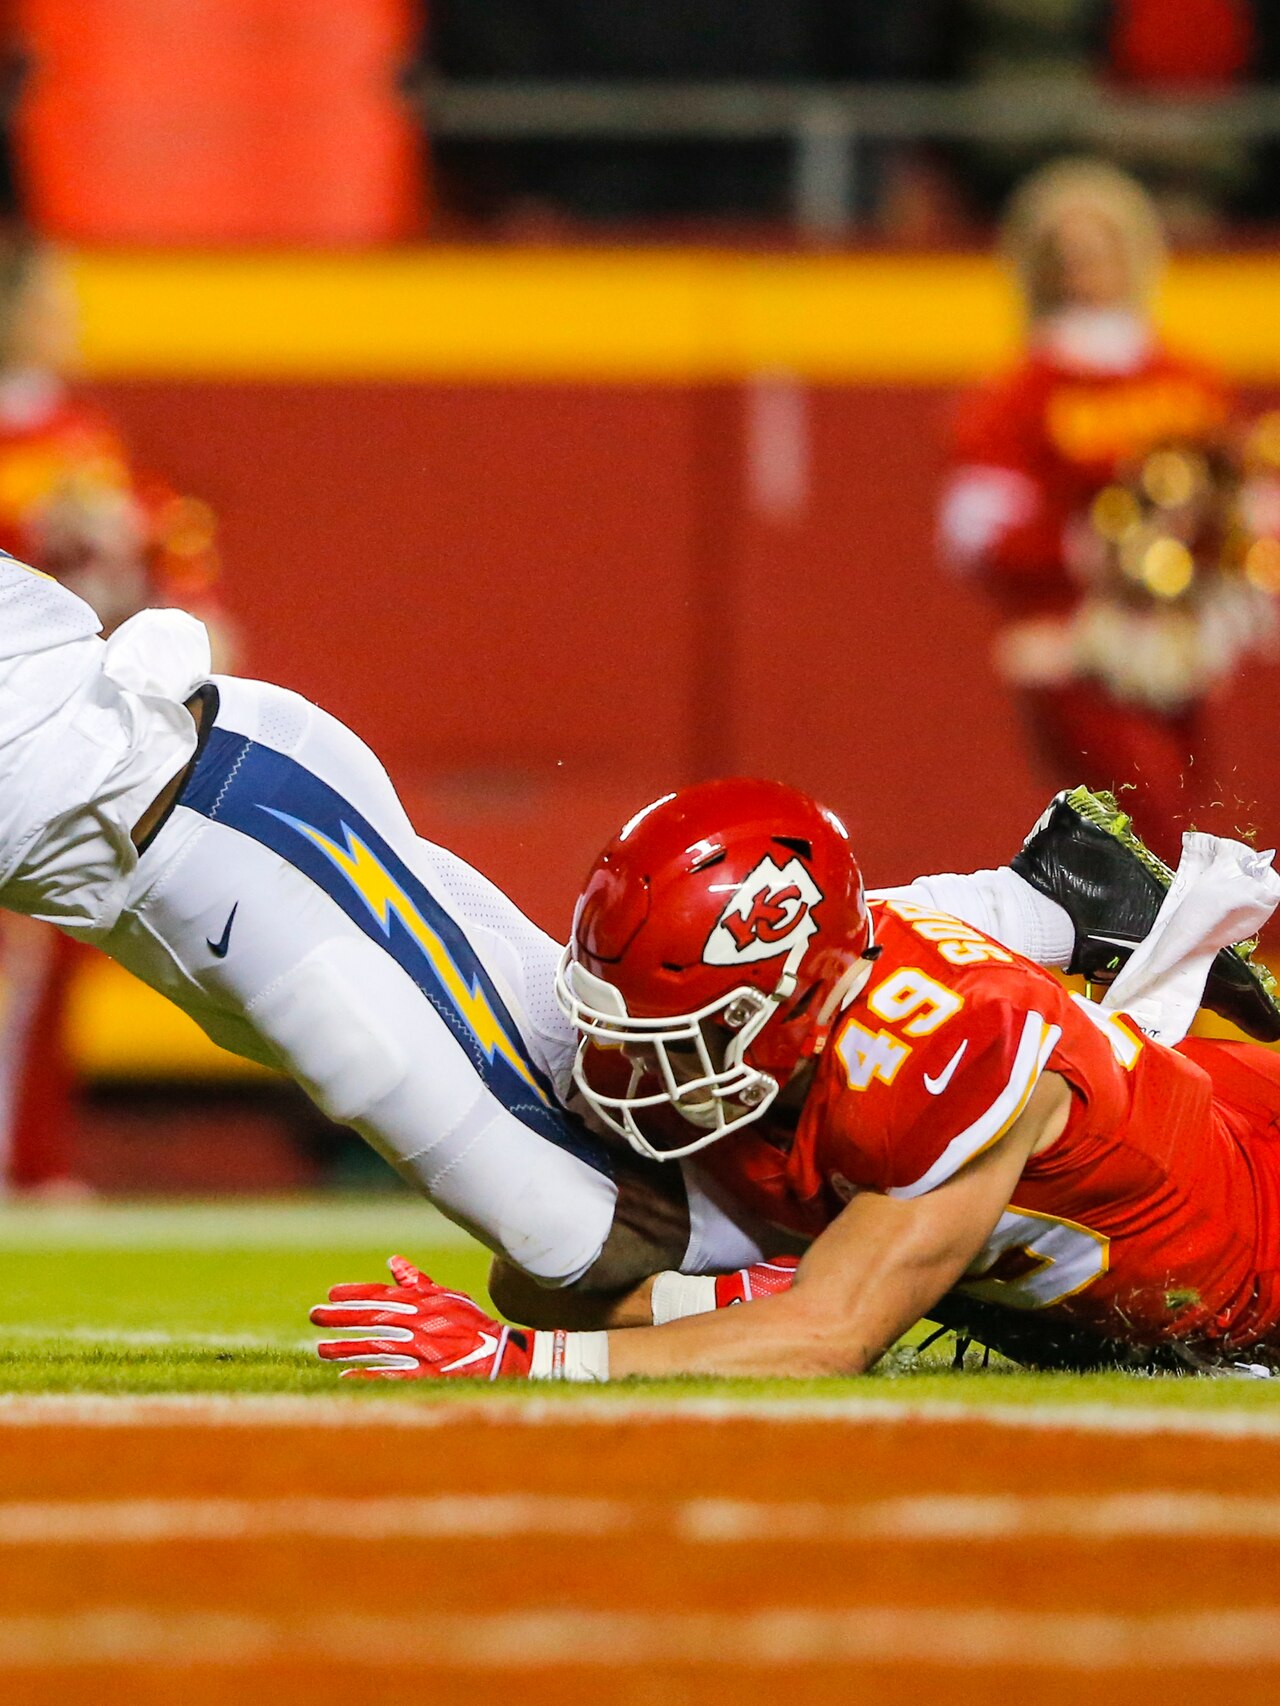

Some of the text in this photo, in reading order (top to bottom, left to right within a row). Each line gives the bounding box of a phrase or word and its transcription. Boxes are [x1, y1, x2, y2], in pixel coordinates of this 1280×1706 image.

[720, 885, 809, 953] KC
[866, 899, 1014, 966] SOR
[834, 966, 966, 1092] 49
